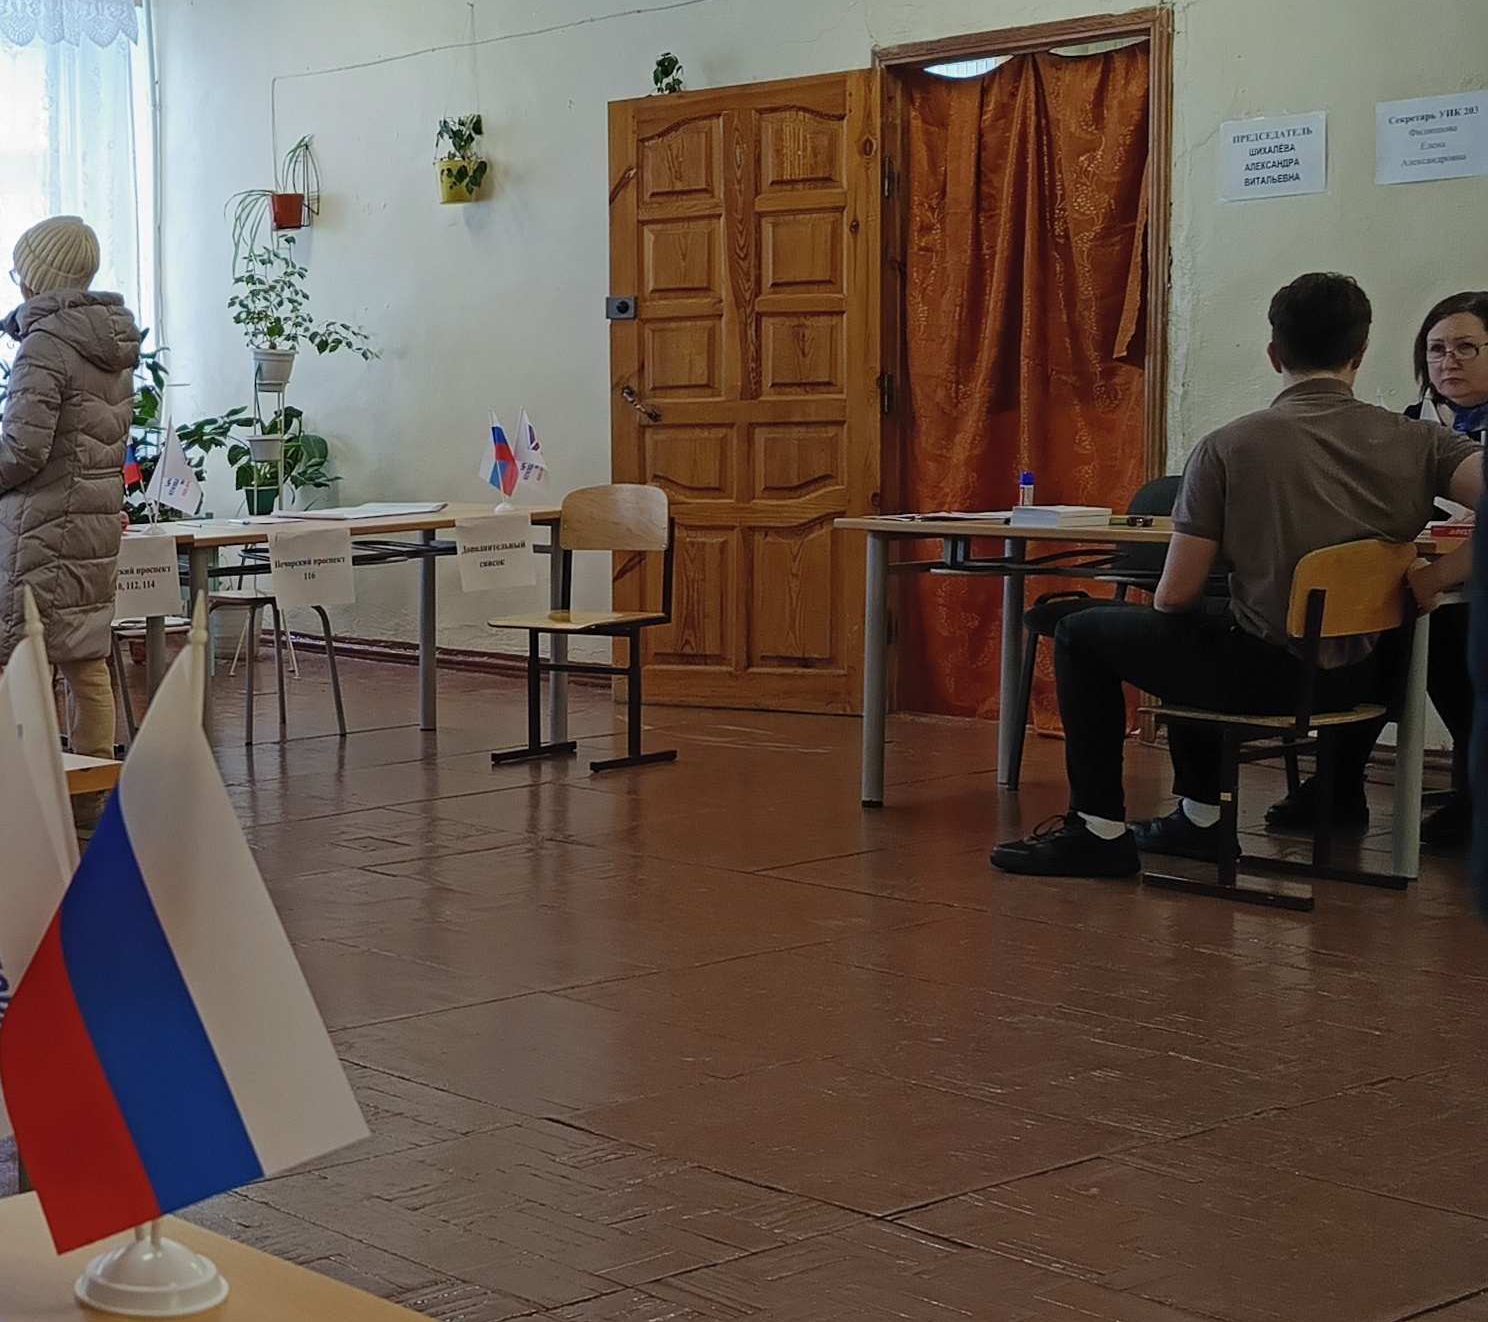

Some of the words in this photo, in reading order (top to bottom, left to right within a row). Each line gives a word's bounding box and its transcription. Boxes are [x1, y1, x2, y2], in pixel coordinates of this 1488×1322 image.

[1232, 126, 1313, 144] ПРЕДСЕДАТЕЛЬ
[1244, 158, 1300, 171] АЛЕКСАНДРА
[1244, 172, 1301, 186] ВИТАЛЬЕВНА
